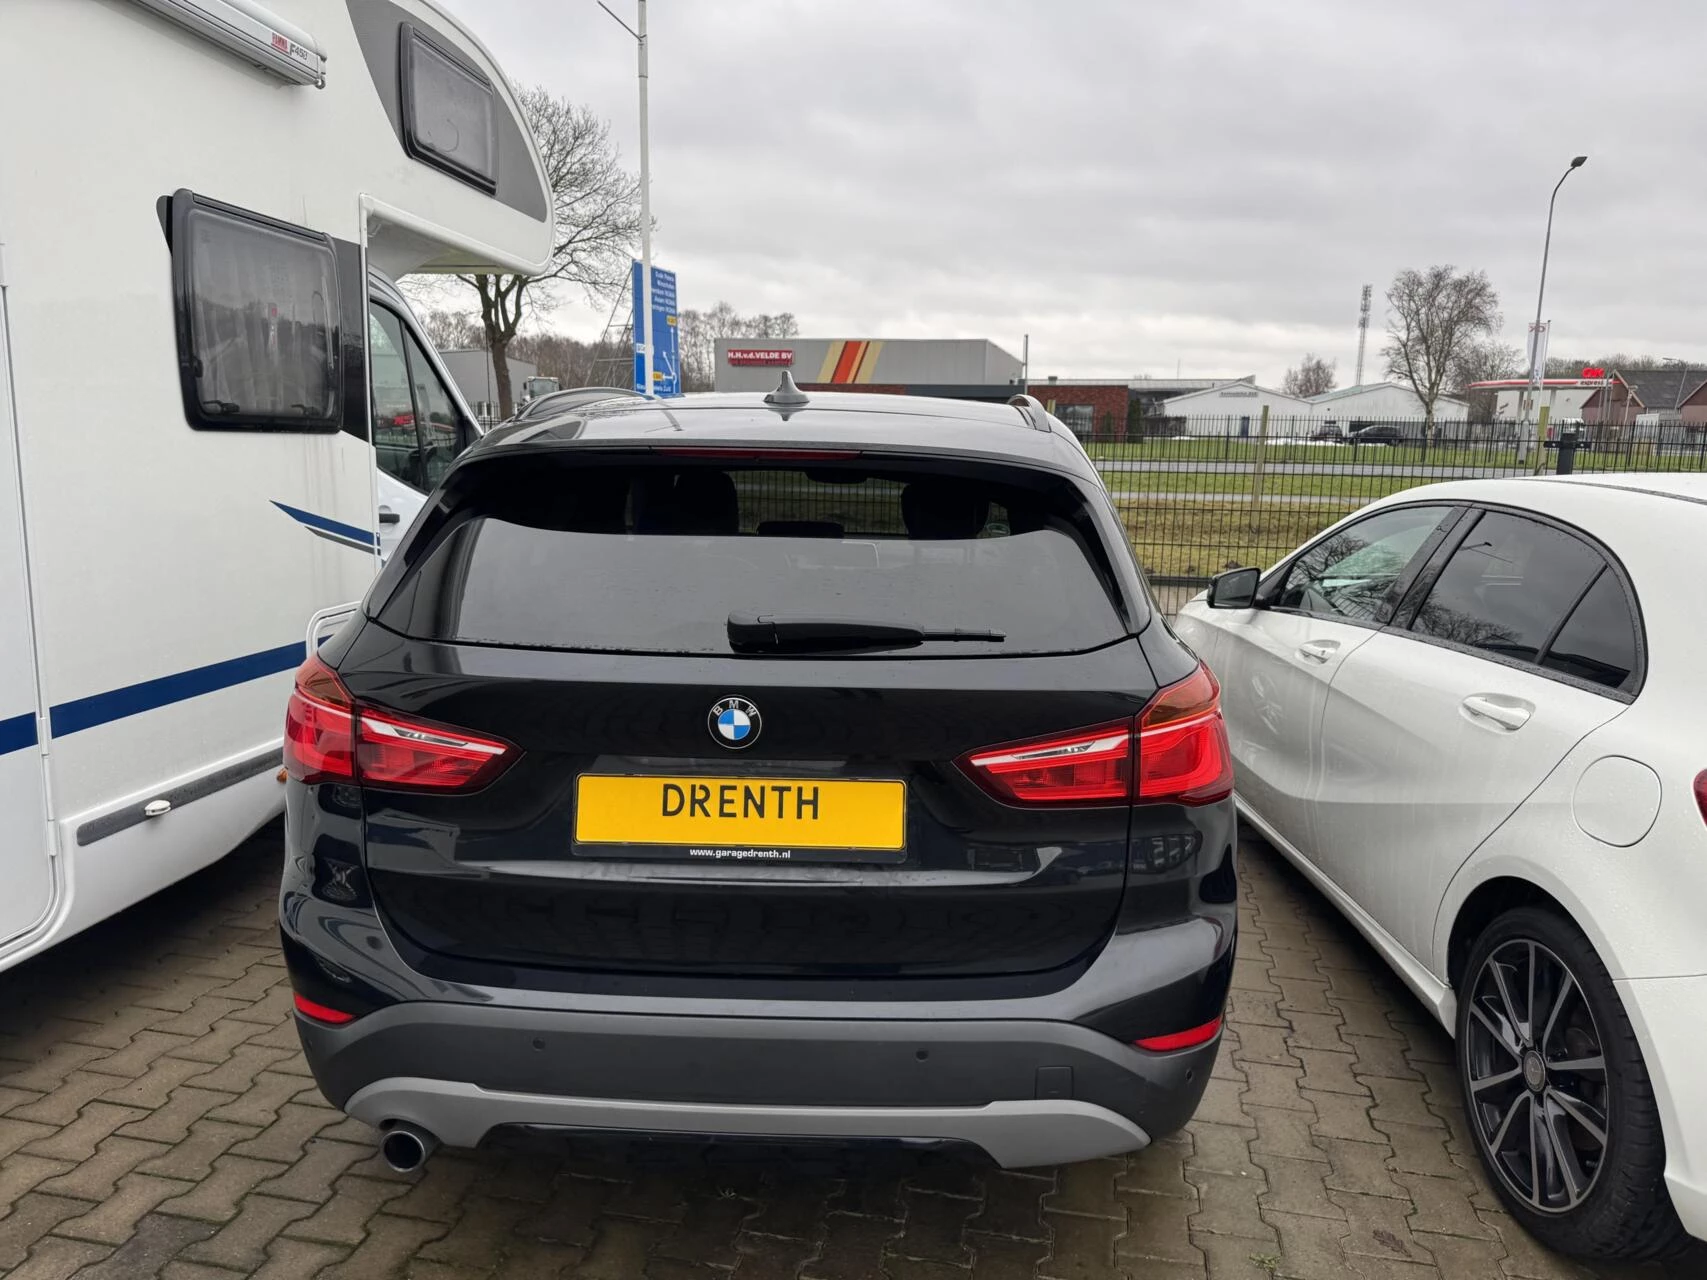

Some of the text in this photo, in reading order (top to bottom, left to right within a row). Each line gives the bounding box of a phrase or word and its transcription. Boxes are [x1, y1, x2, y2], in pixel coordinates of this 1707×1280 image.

[712, 699, 757, 717] BMW
[662, 783, 819, 820] DRENTH
[689, 848, 791, 859] www.garagedrenth.nl
